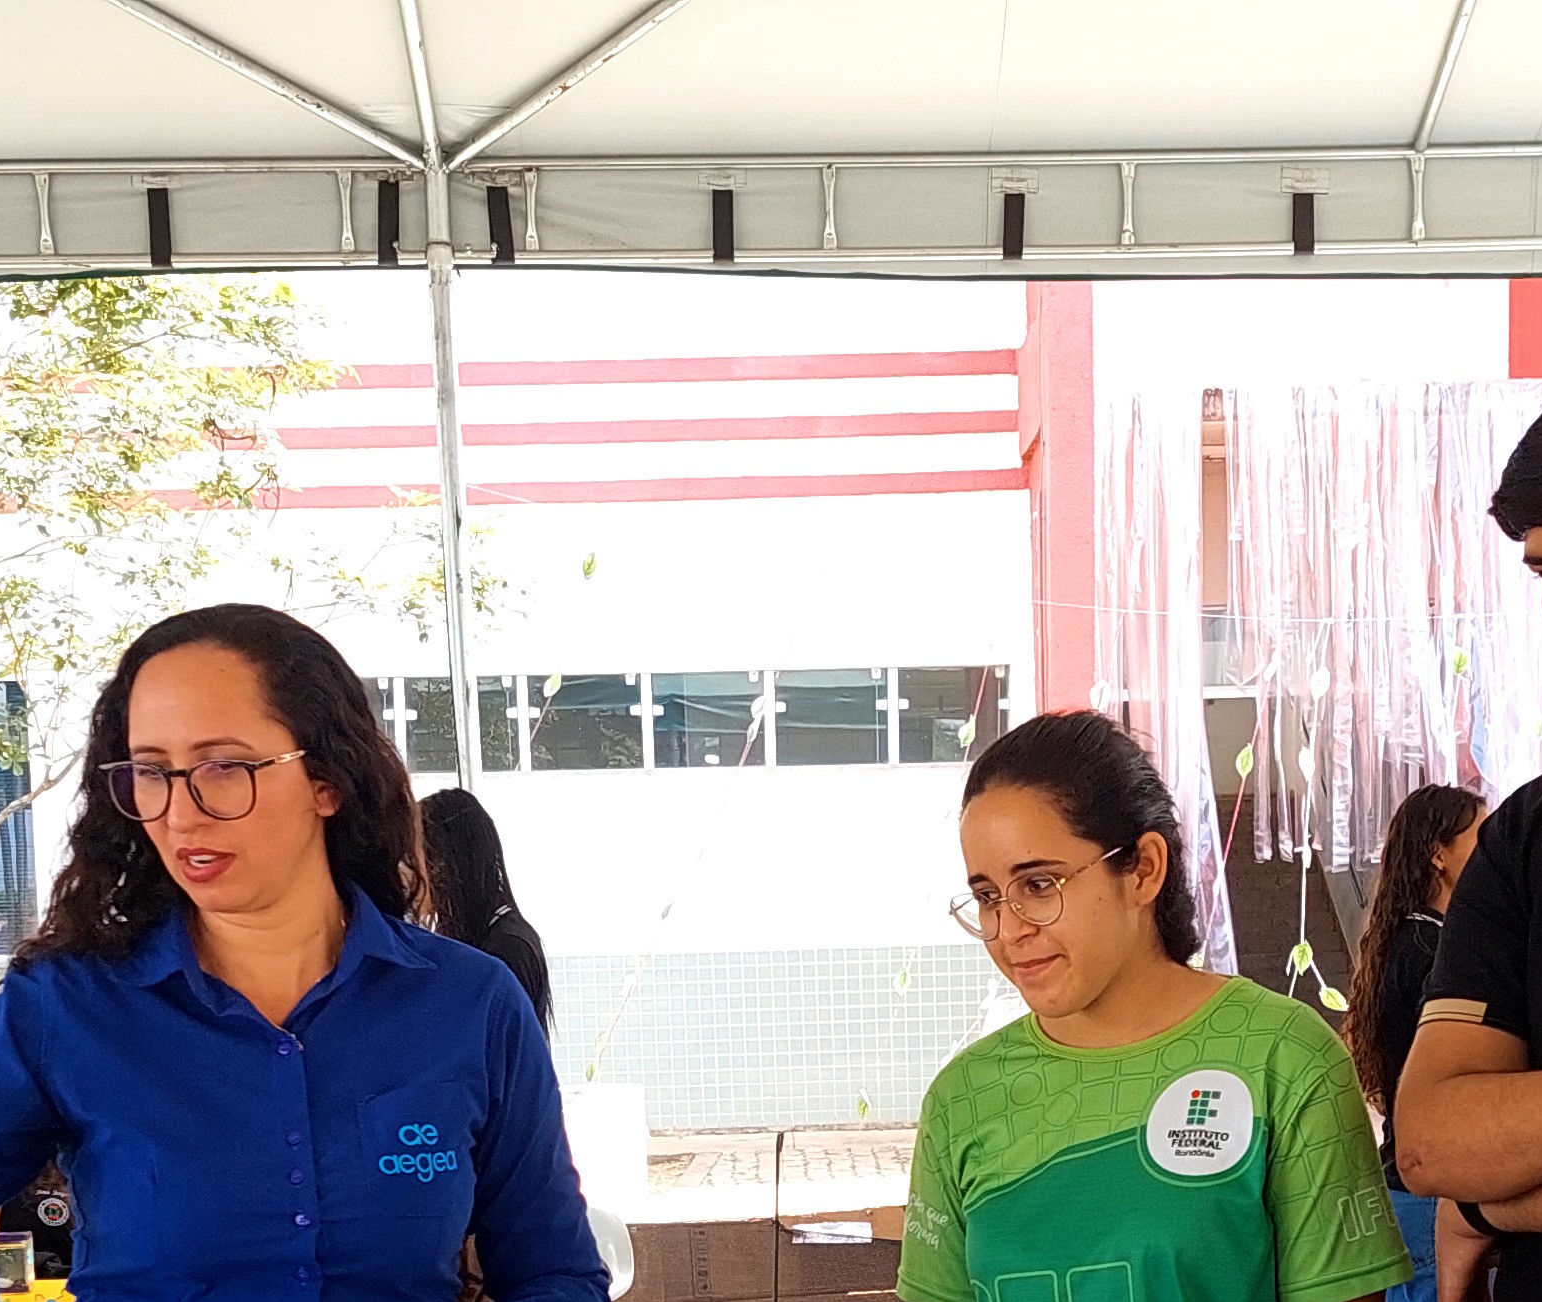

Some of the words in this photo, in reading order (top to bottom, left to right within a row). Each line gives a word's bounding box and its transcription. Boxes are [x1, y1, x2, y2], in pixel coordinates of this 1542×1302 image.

[1167, 1129, 1230, 1141] INSTITUTO
[1171, 1138, 1223, 1150] FEDERAL
[378, 1150, 458, 1183] aegea
